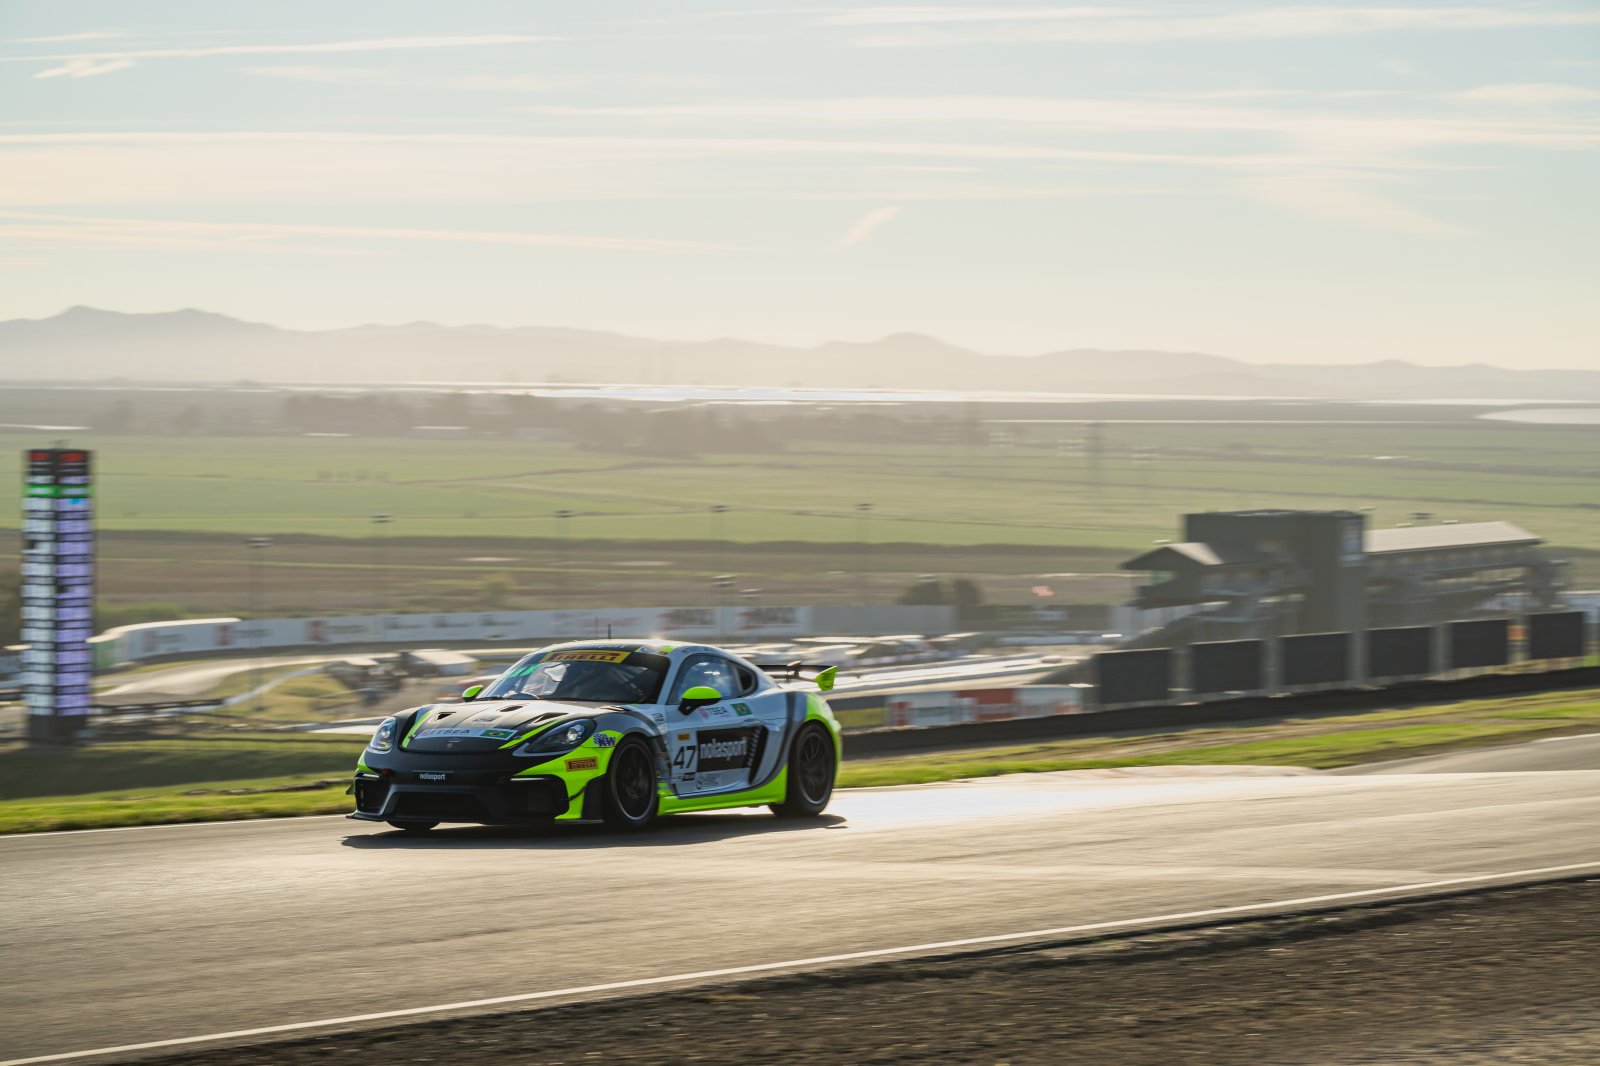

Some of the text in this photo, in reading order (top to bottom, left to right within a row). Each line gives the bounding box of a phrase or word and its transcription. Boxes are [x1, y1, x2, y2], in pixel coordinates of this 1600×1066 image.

[548, 651, 620, 661] PIRELLI
[599, 736, 616, 747] KW
[700, 736, 747, 761] nolasport
[673, 745, 696, 769] 47
[567, 758, 596, 770] PIRELLI
[420, 773, 445, 781] nolasport
